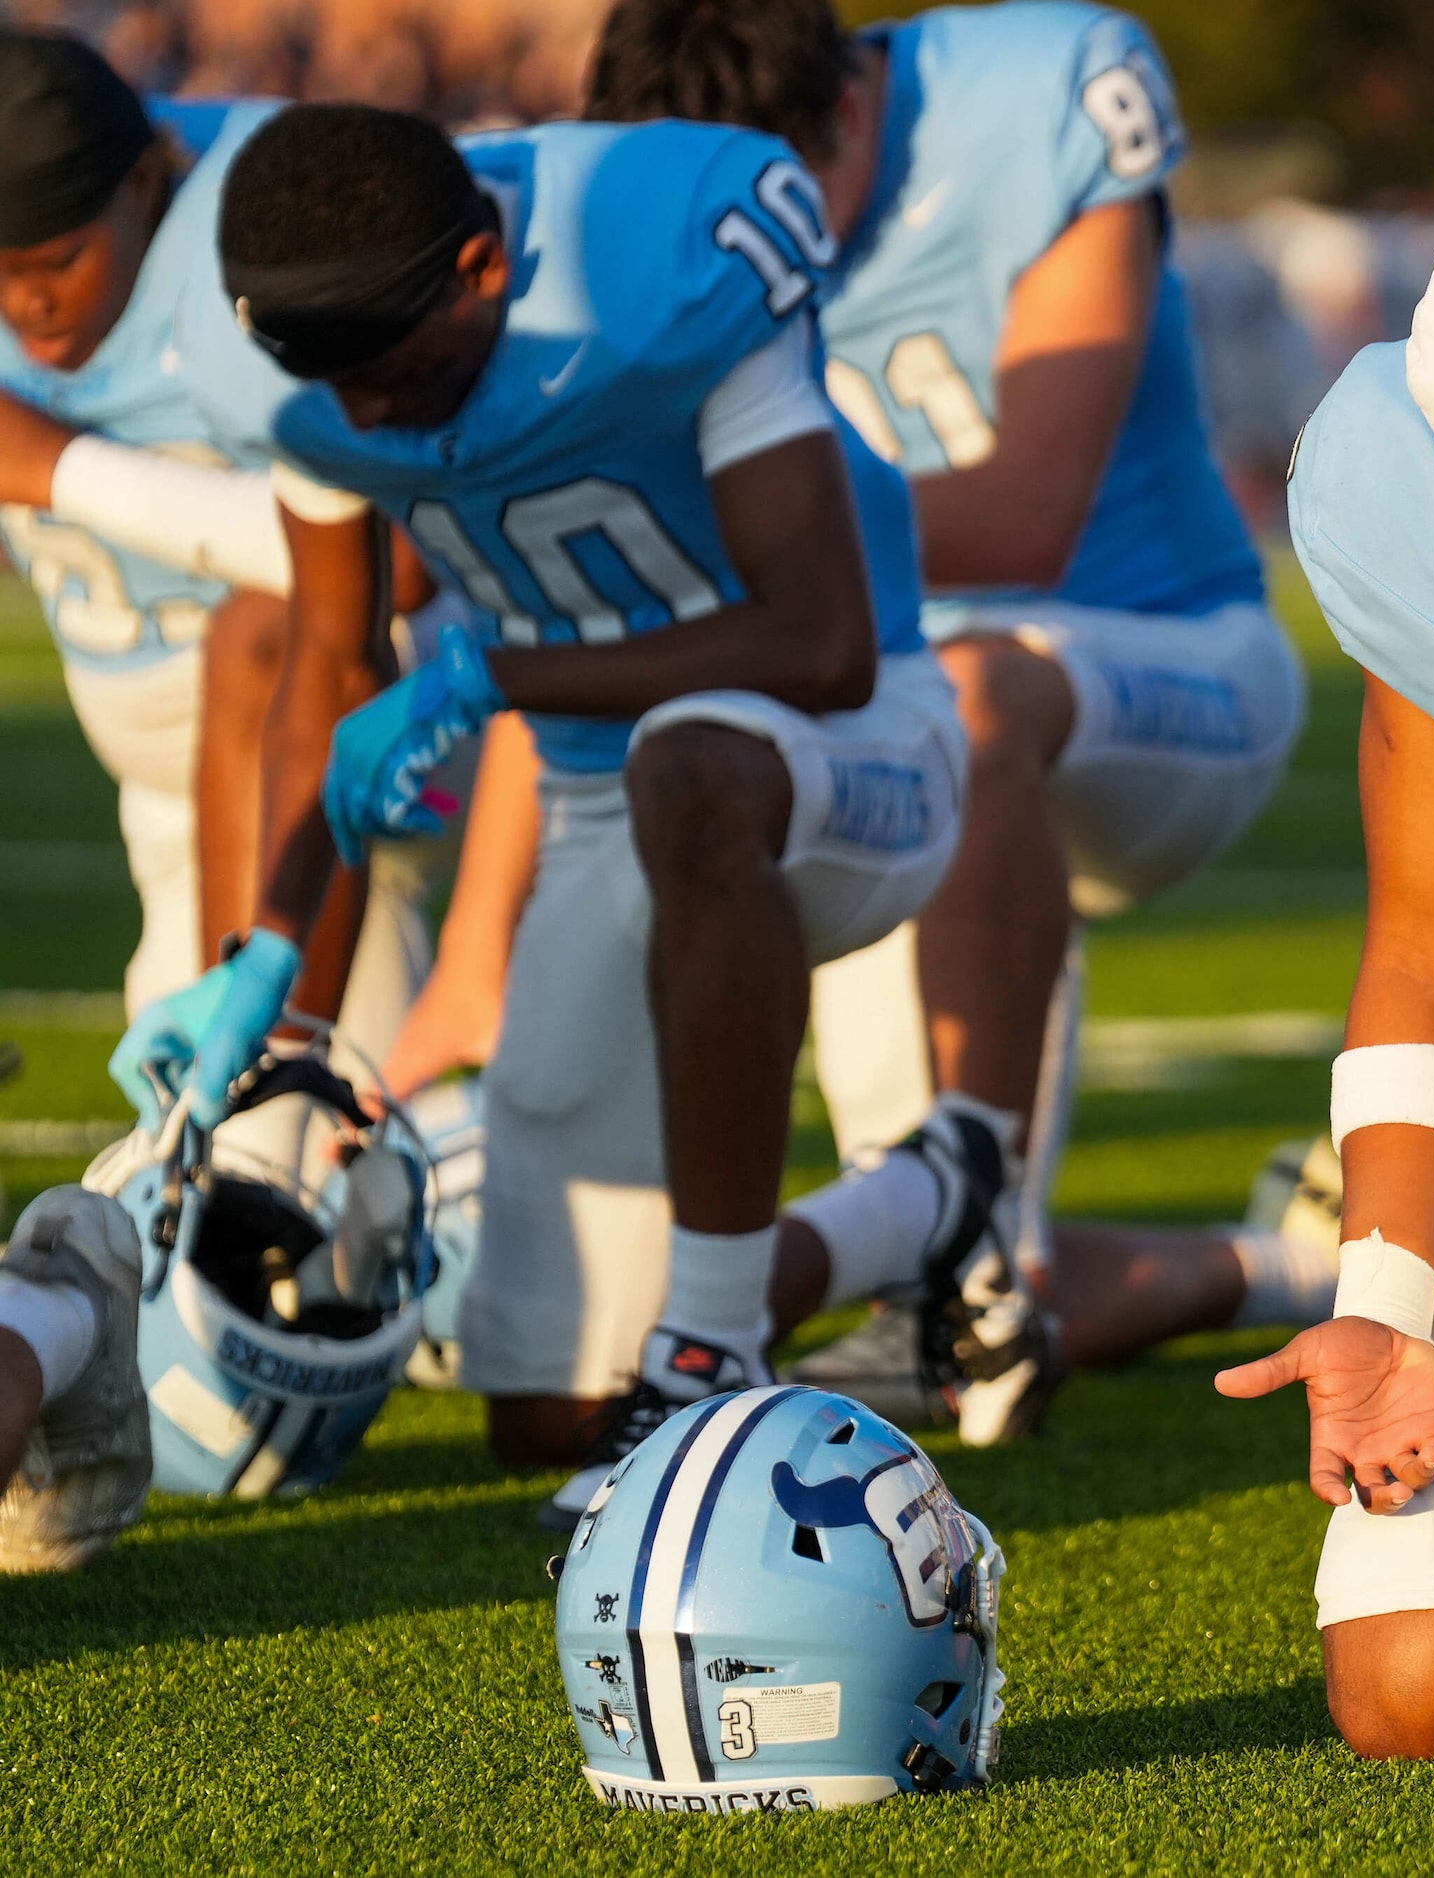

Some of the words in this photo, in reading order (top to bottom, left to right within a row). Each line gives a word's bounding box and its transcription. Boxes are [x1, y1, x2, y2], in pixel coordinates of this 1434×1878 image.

[714, 160, 838, 318] 10
[409, 476, 720, 647] 10
[717, 1699, 758, 1761] 3
[760, 1687, 804, 1697] WARNING
